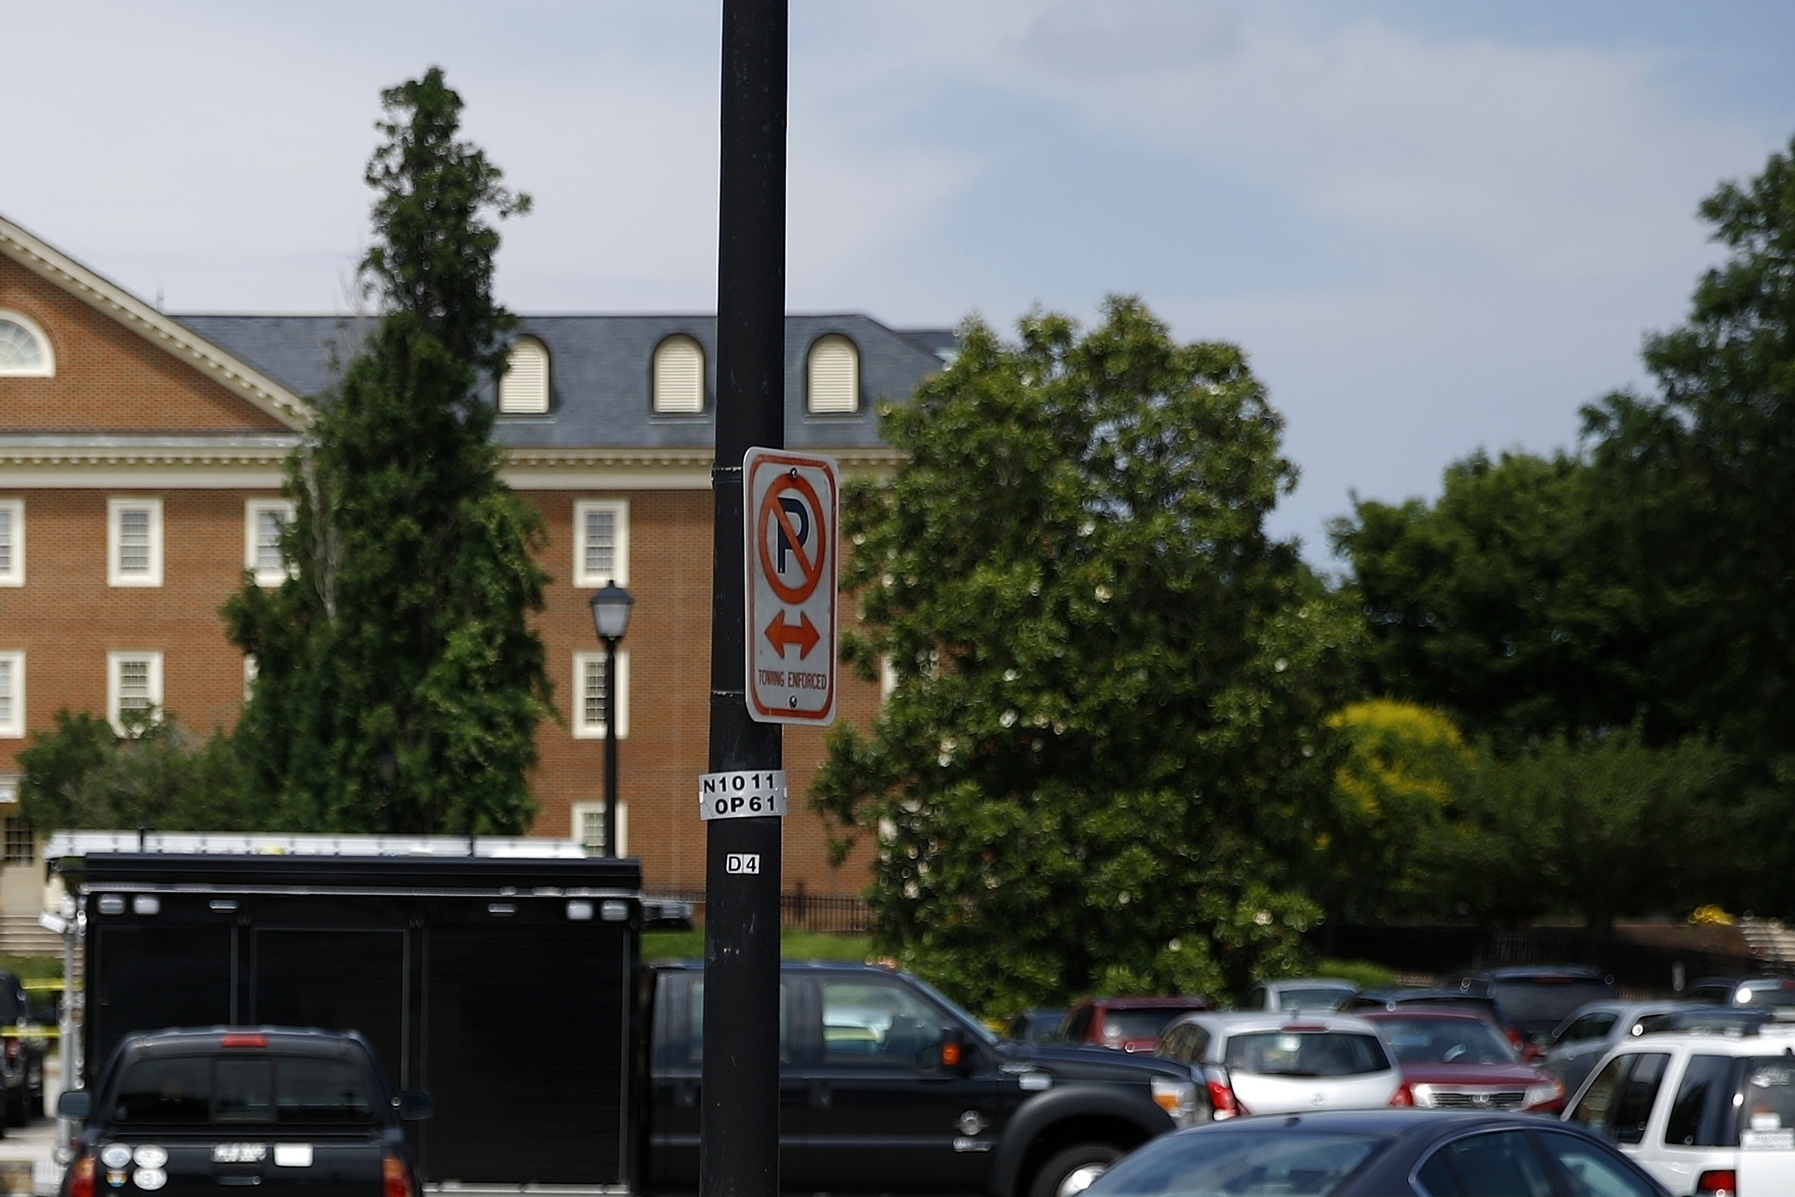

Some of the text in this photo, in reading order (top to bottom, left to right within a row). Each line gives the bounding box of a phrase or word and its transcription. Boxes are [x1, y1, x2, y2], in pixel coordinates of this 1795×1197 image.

[758, 669, 827, 690] TOWING ENFORCED
[704, 773, 774, 794] N1011
[728, 856, 757, 872] D4
